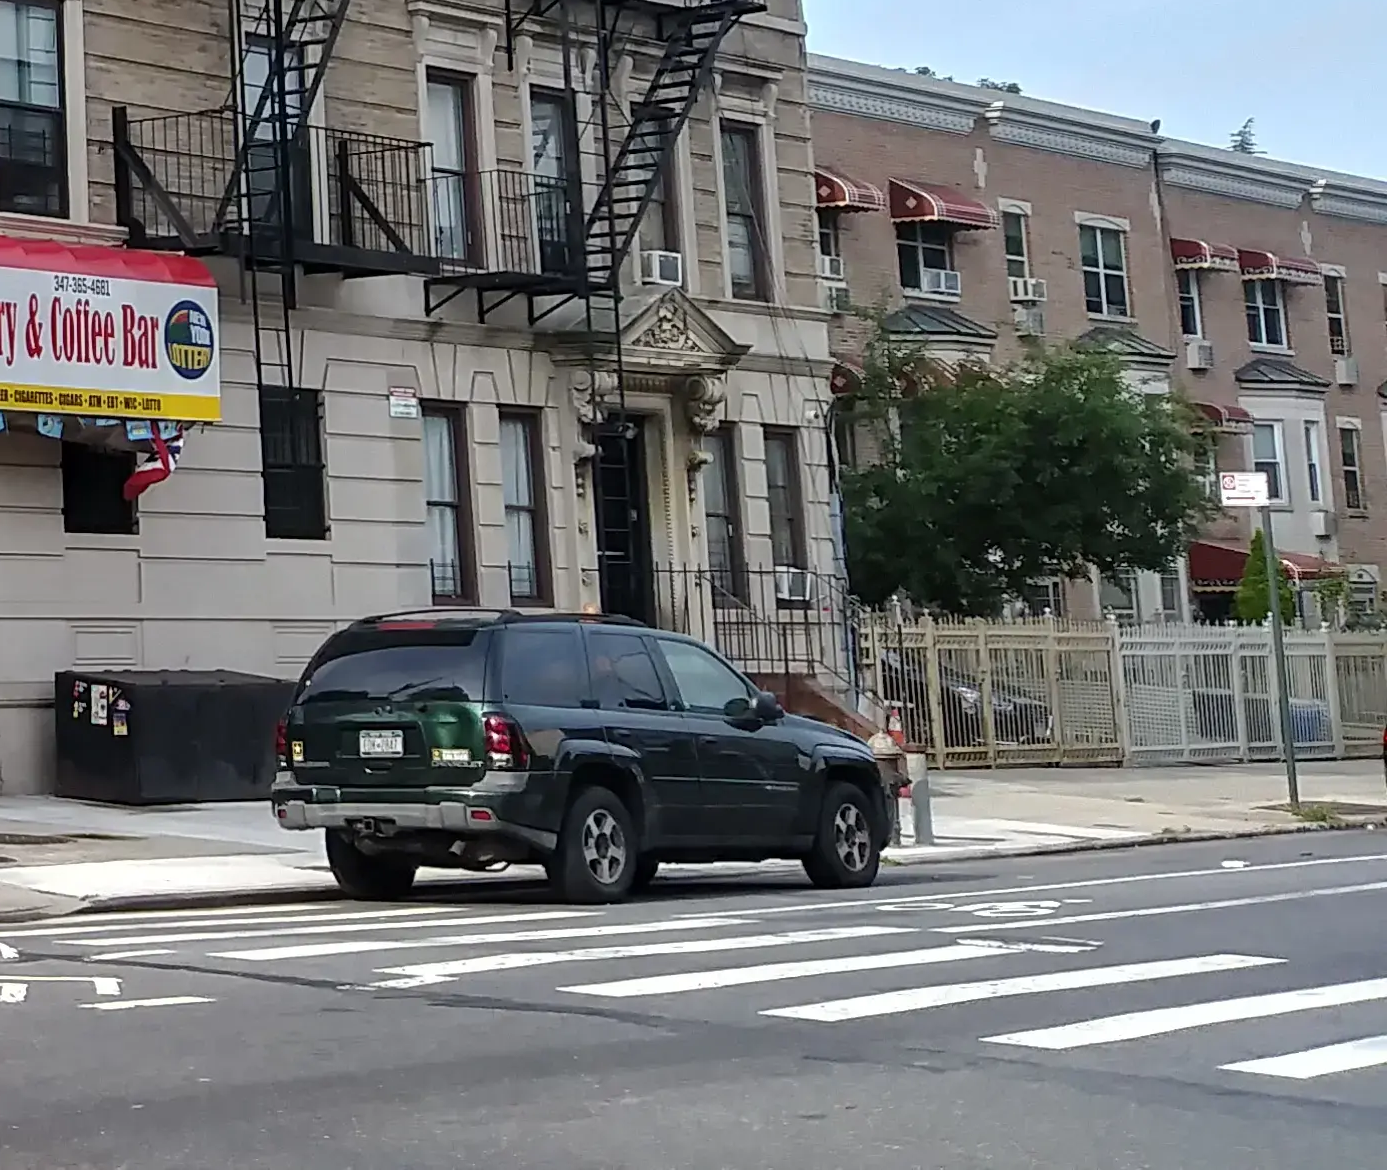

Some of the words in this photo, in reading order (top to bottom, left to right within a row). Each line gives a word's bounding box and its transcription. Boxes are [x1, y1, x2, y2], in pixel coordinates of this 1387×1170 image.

[54, 276, 110, 297] 347-365-4681
[25, 293, 43, 359] &
[50, 295, 116, 366] Coffee
[121, 304, 159, 369] Bar
[14, 389, 53, 405] CIGARETTES
[59, 392, 83, 407] CIGARS
[88, 395, 102, 408] ATM
[107, 396, 119, 409] EBT
[124, 397, 137, 410] WIC
[142, 398, 161, 411] LOTTO
